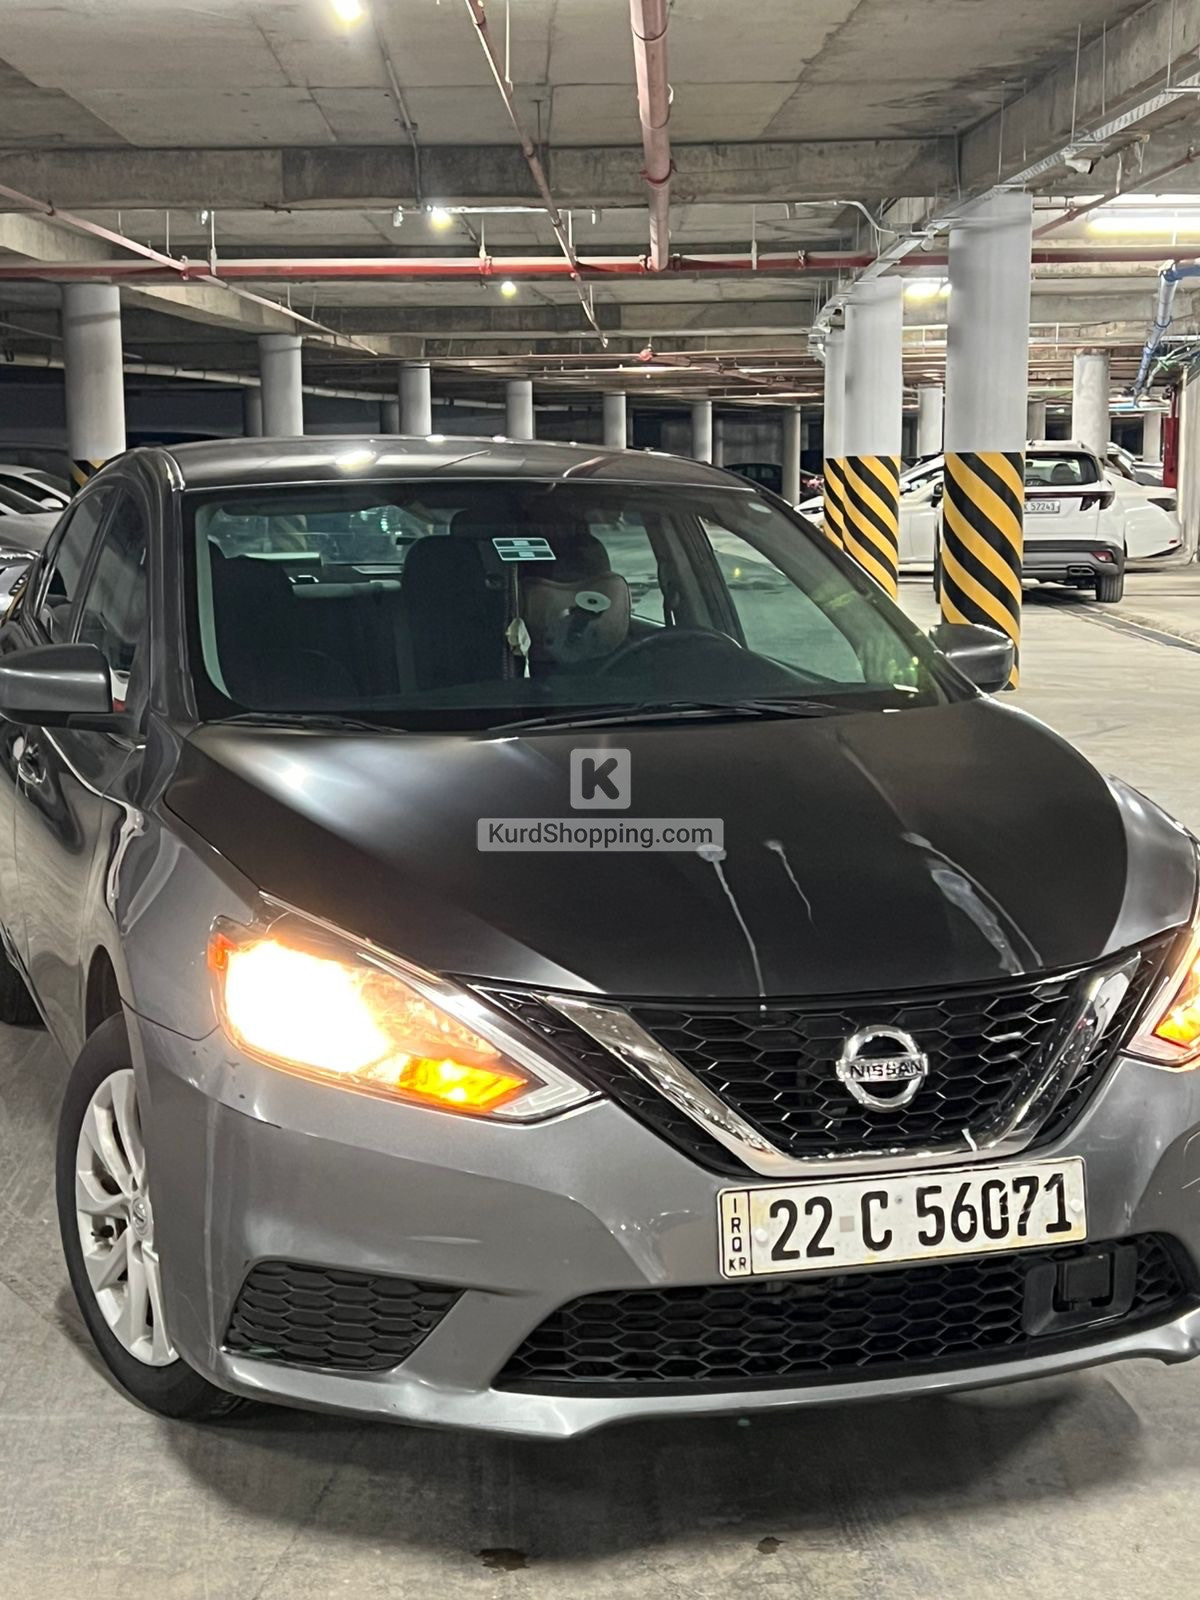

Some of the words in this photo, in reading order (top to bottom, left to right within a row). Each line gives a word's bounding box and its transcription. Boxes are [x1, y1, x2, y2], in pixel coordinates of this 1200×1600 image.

[850, 1061, 923, 1078] NISSAN
[769, 1196, 835, 1261] 22
[860, 1190, 893, 1251] C
[916, 1173, 1072, 1246] 56071
[729, 1256, 747, 1271] KR
